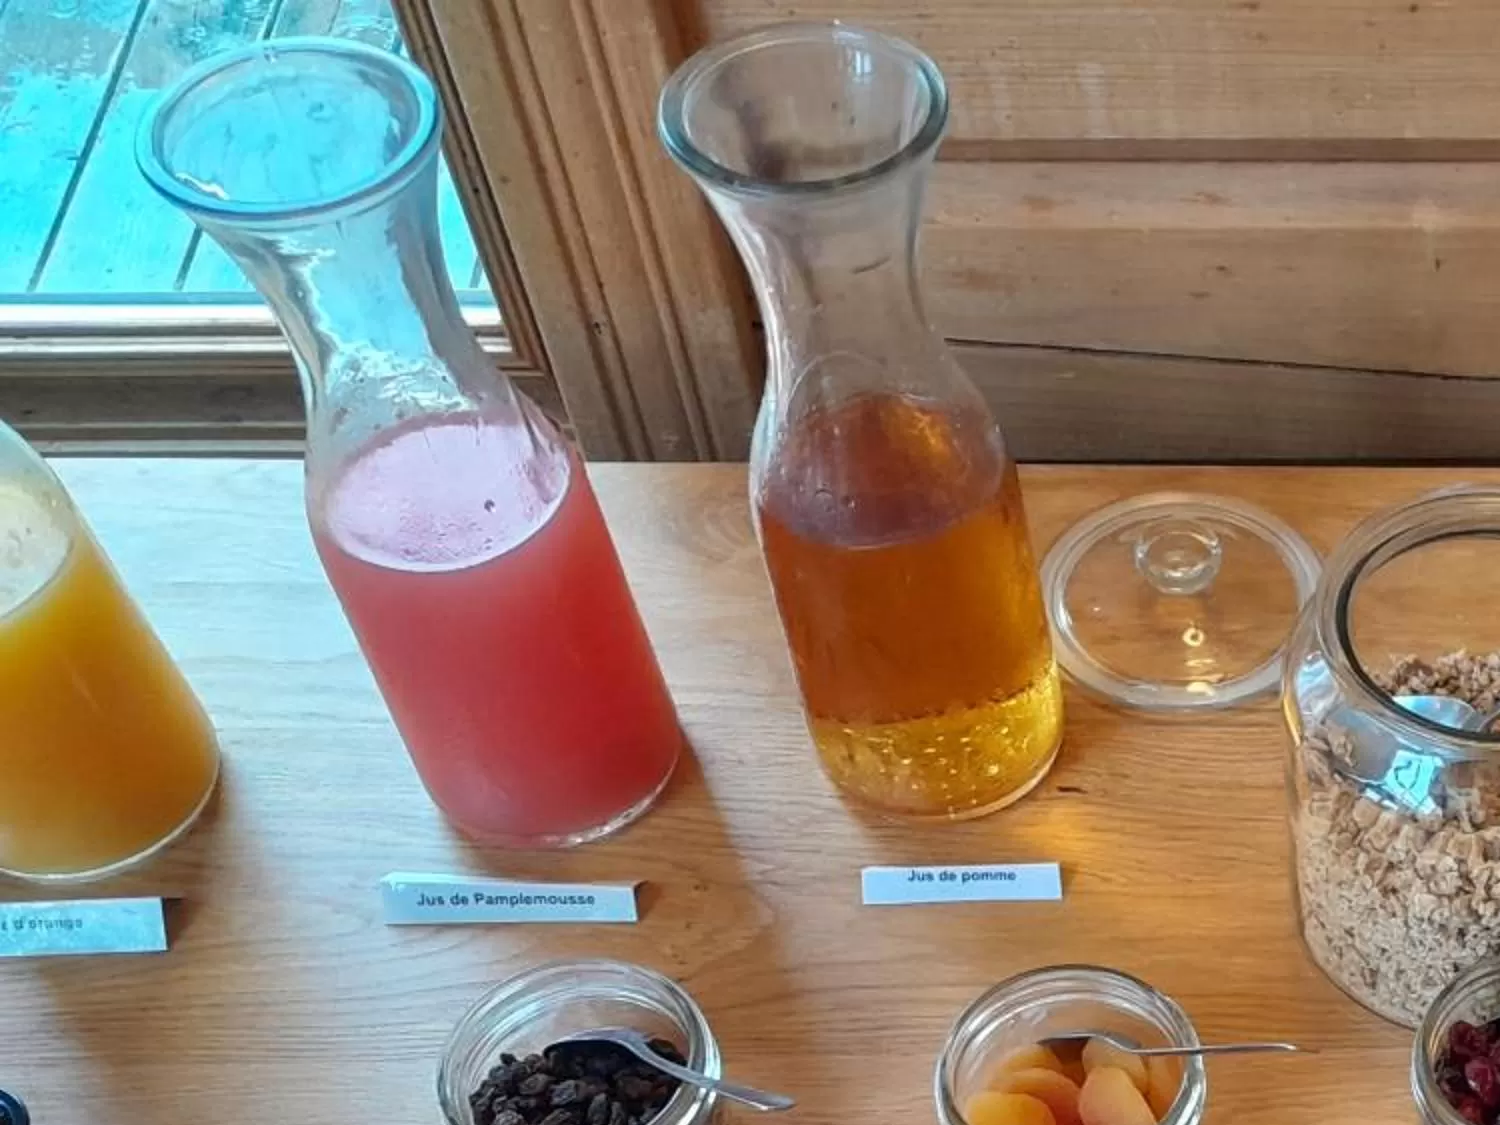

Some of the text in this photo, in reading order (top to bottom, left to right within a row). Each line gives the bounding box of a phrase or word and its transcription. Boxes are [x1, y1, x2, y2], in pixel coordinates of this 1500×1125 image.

[908, 869, 1016, 884] Jus de pomme
[417, 892, 596, 908] Jus de Pamplemousse
